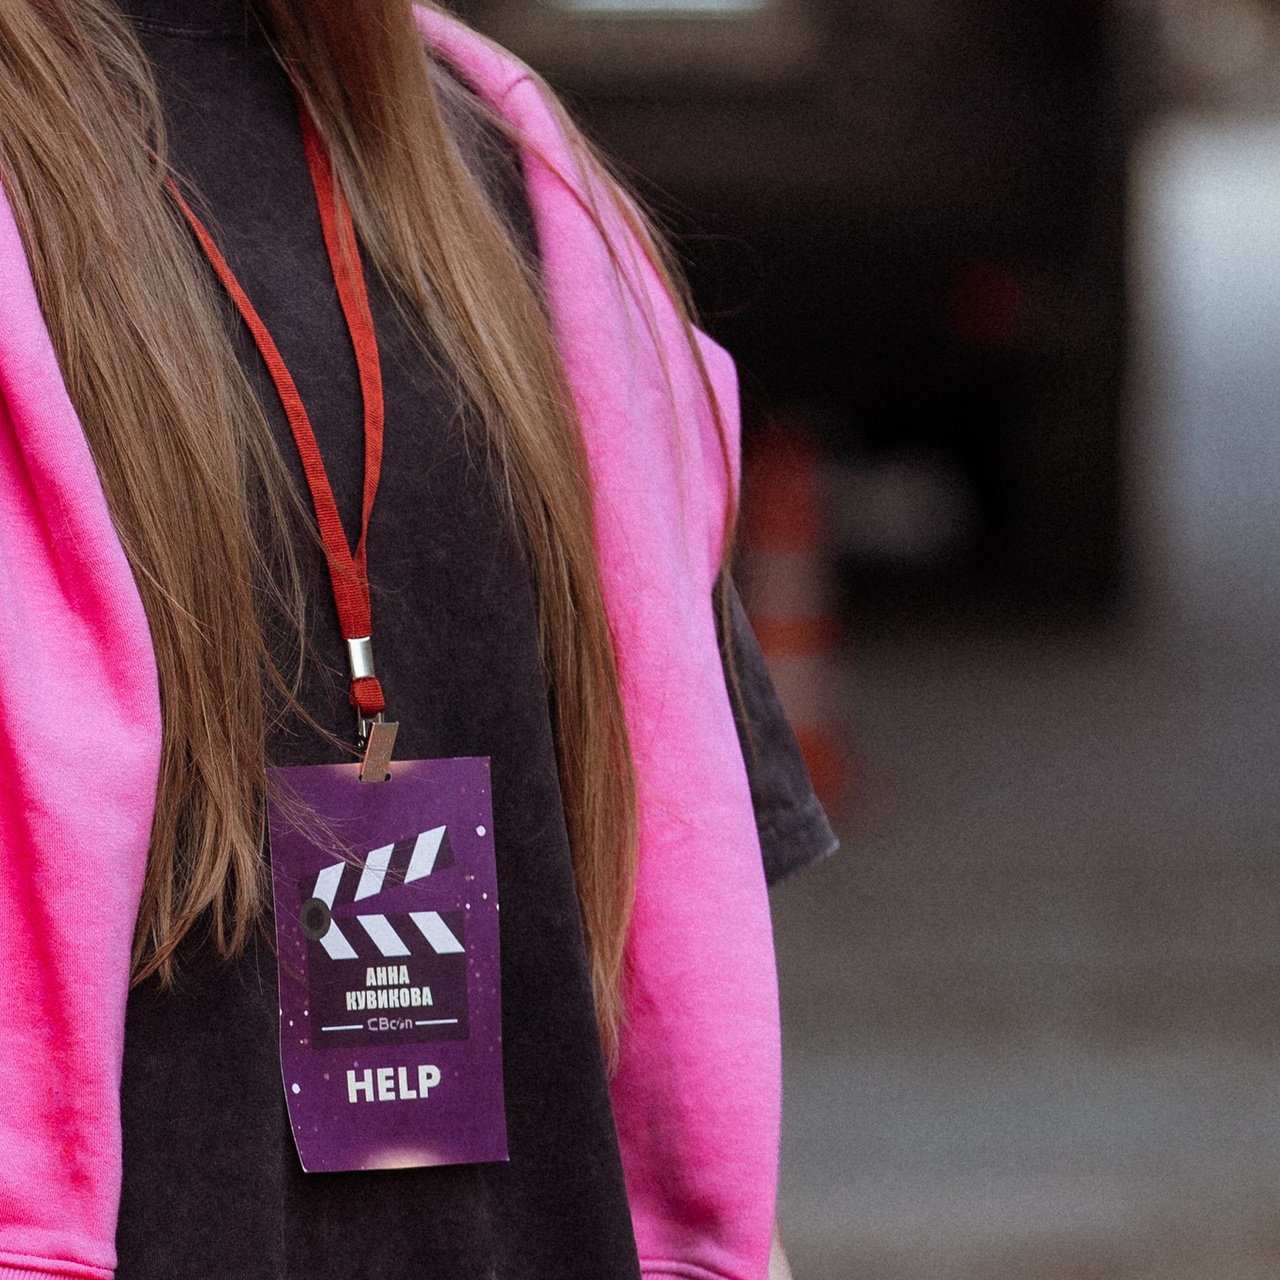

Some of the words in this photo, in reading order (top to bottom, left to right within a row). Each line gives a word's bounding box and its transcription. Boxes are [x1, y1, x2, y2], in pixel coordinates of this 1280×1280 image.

[365, 965, 410, 986] АННА
[346, 986, 433, 1010] КУВИКОВА
[347, 1064, 441, 1103] HELP
